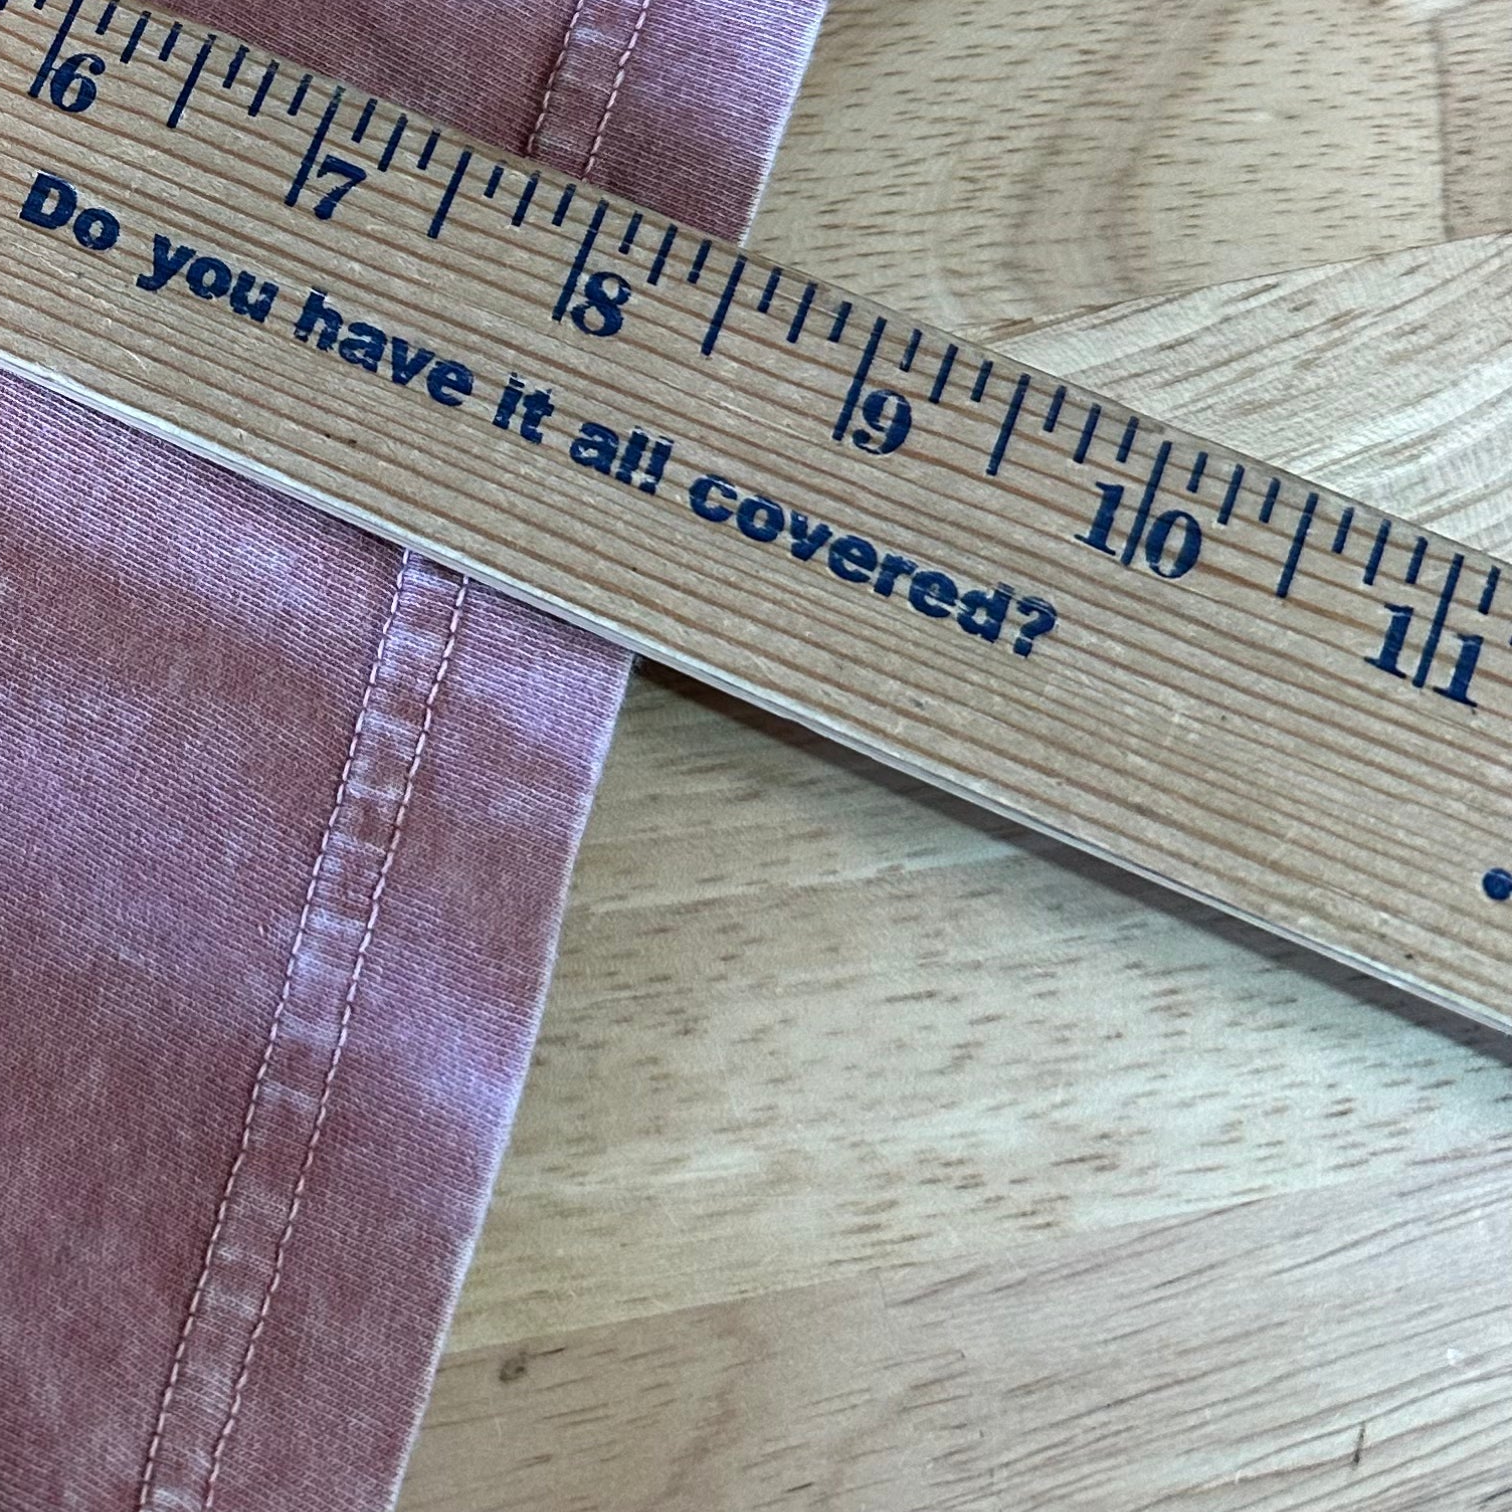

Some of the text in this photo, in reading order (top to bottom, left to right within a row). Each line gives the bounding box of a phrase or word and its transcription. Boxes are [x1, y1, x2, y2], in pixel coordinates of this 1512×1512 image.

[19, 172, 1058, 658] Do you have it all covered?
[51, 52, 108, 113] 6
[314, 155, 368, 221] 7
[570, 271, 632, 338] 8
[851, 390, 913, 456] 9
[1074, 480, 1203, 579] 10
[1364, 603, 1484, 709] 11
